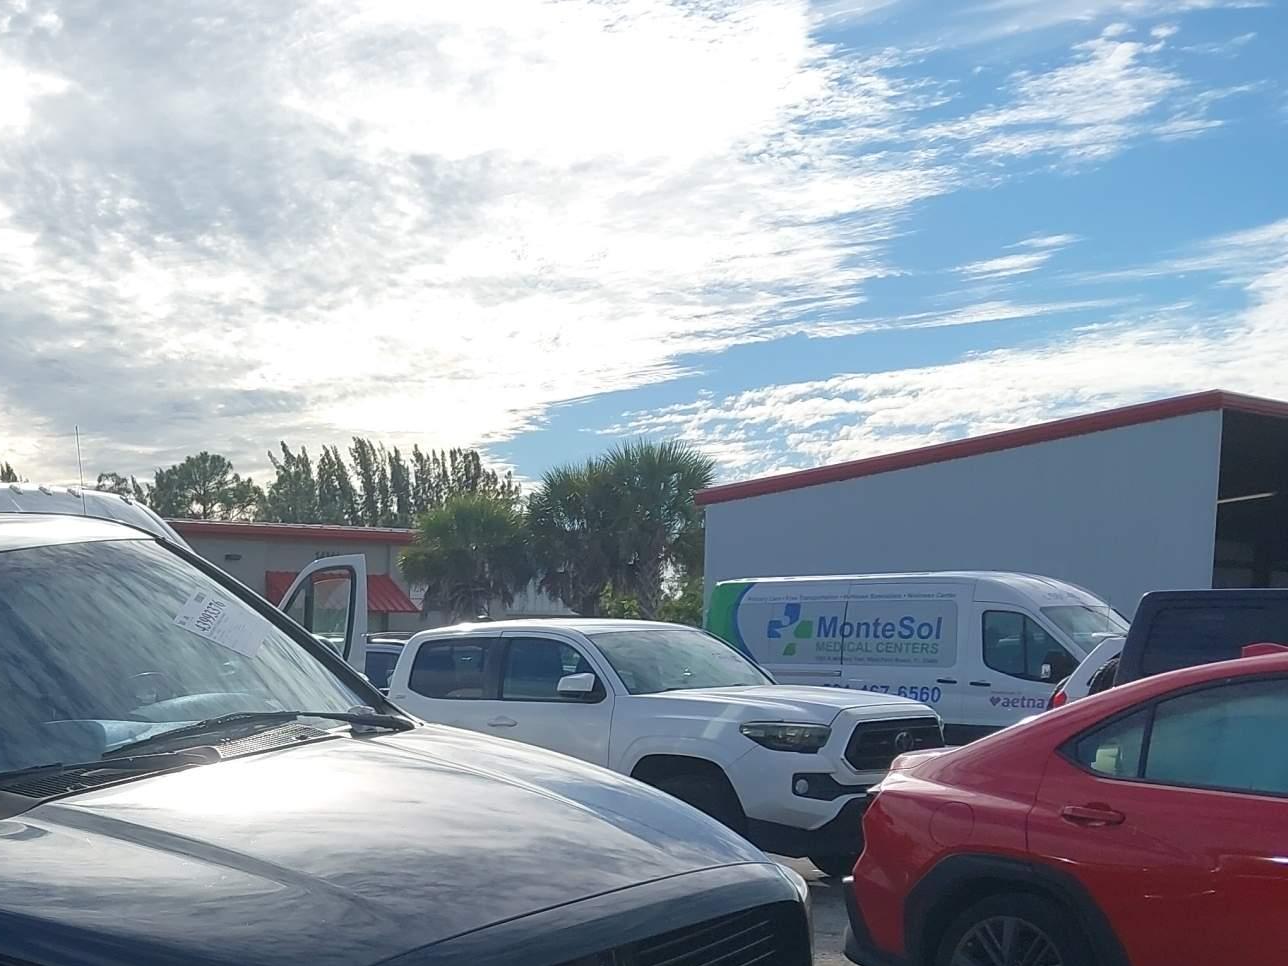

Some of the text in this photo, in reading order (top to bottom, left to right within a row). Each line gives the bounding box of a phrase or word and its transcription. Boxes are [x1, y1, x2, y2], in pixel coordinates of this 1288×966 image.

[194, 599, 226, 631] 43993376
[816, 616, 943, 640] MonteSol
[816, 641, 939, 655] MEDICAL CENTERS
[1001, 695, 1045, 709] aetna
